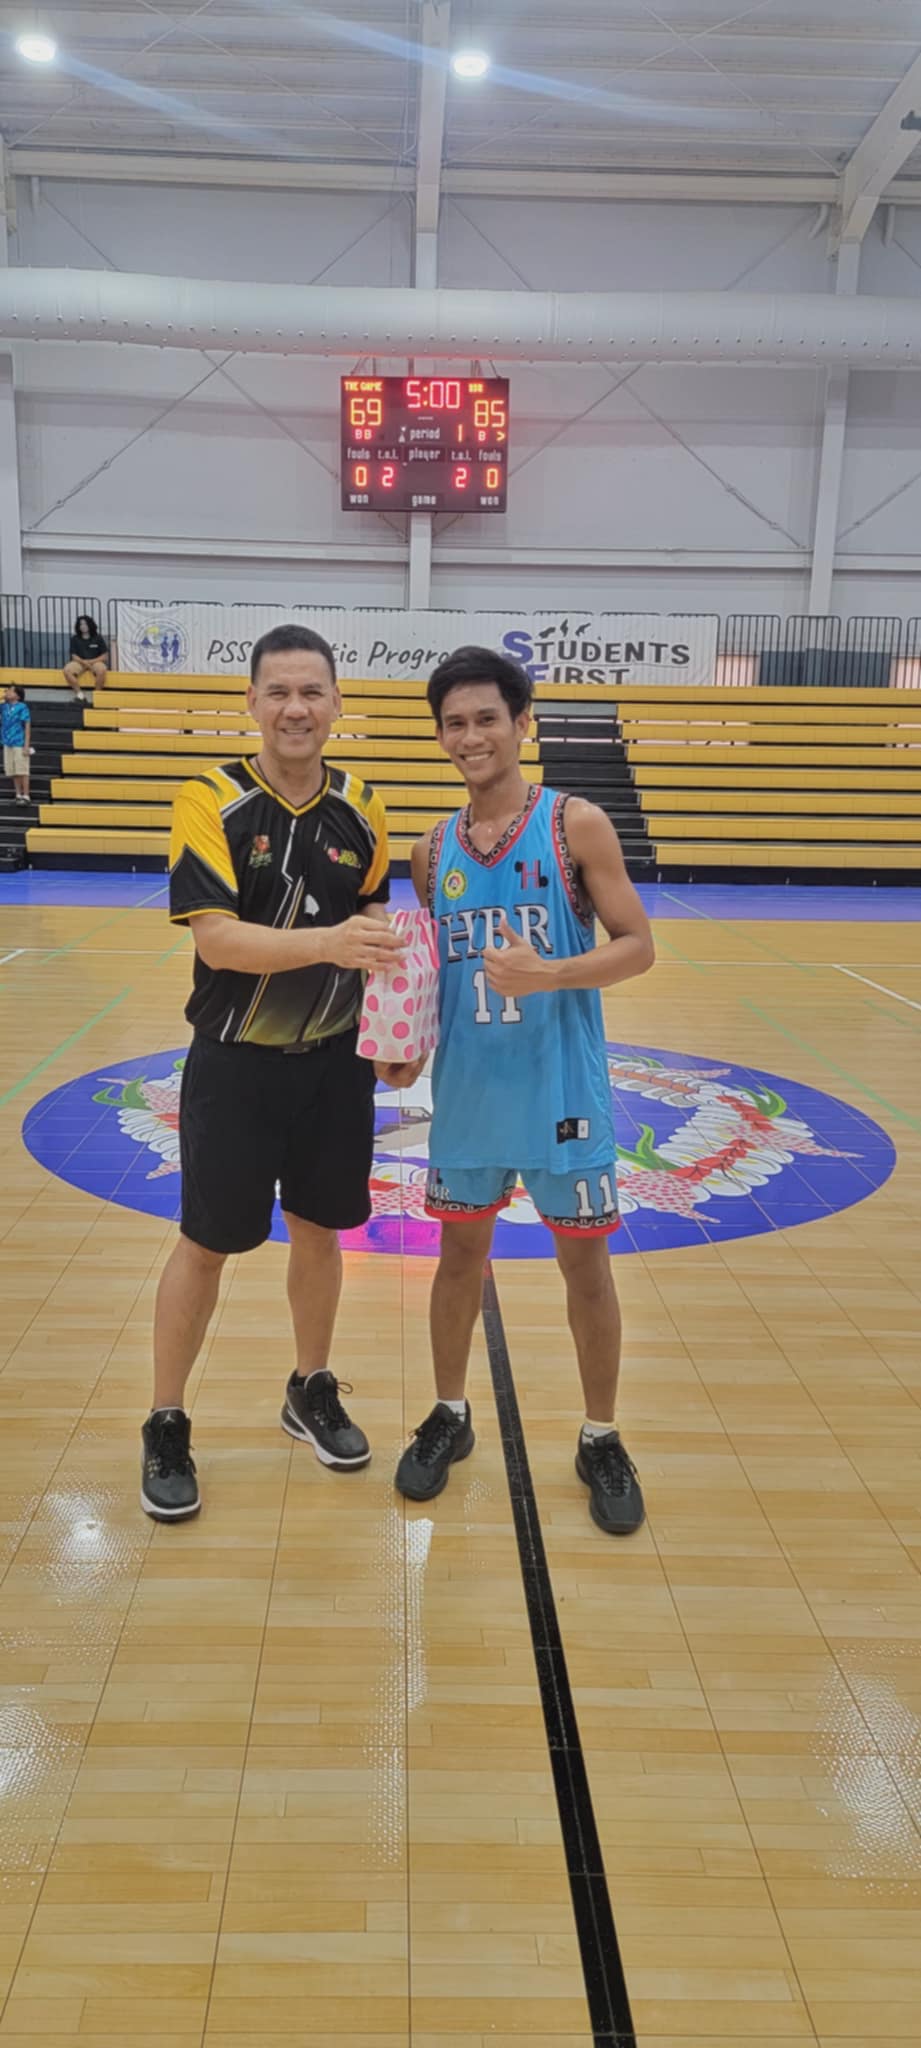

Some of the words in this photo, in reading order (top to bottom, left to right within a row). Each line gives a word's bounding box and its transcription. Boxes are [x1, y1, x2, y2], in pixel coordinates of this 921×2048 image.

[344, 381, 359, 391] THE
[406, 380, 460, 409] 5:00
[350, 398, 382, 426] 69
[474, 400, 505, 427] 85
[410, 427, 440, 441] period
[458, 424, 463, 442] 1
[347, 447, 370, 460] fouls
[408, 448, 440, 461] player
[478, 449, 502, 461] fouls
[355, 466, 367, 487] 0
[382, 466, 394, 487] 2
[455, 467, 467, 489] 2
[486, 468, 498, 489] 0
[349, 494, 369, 504] won
[412, 495, 436, 507] game
[480, 495, 499, 506] won
[207, 640, 253, 663] PSS
[368, 641, 450, 669] Progra
[502, 631, 690, 665] STUDENTS
[440, 903, 553, 963] HBR
[428, 1184, 450, 1200] BR
[574, 1173, 615, 1217] 11
